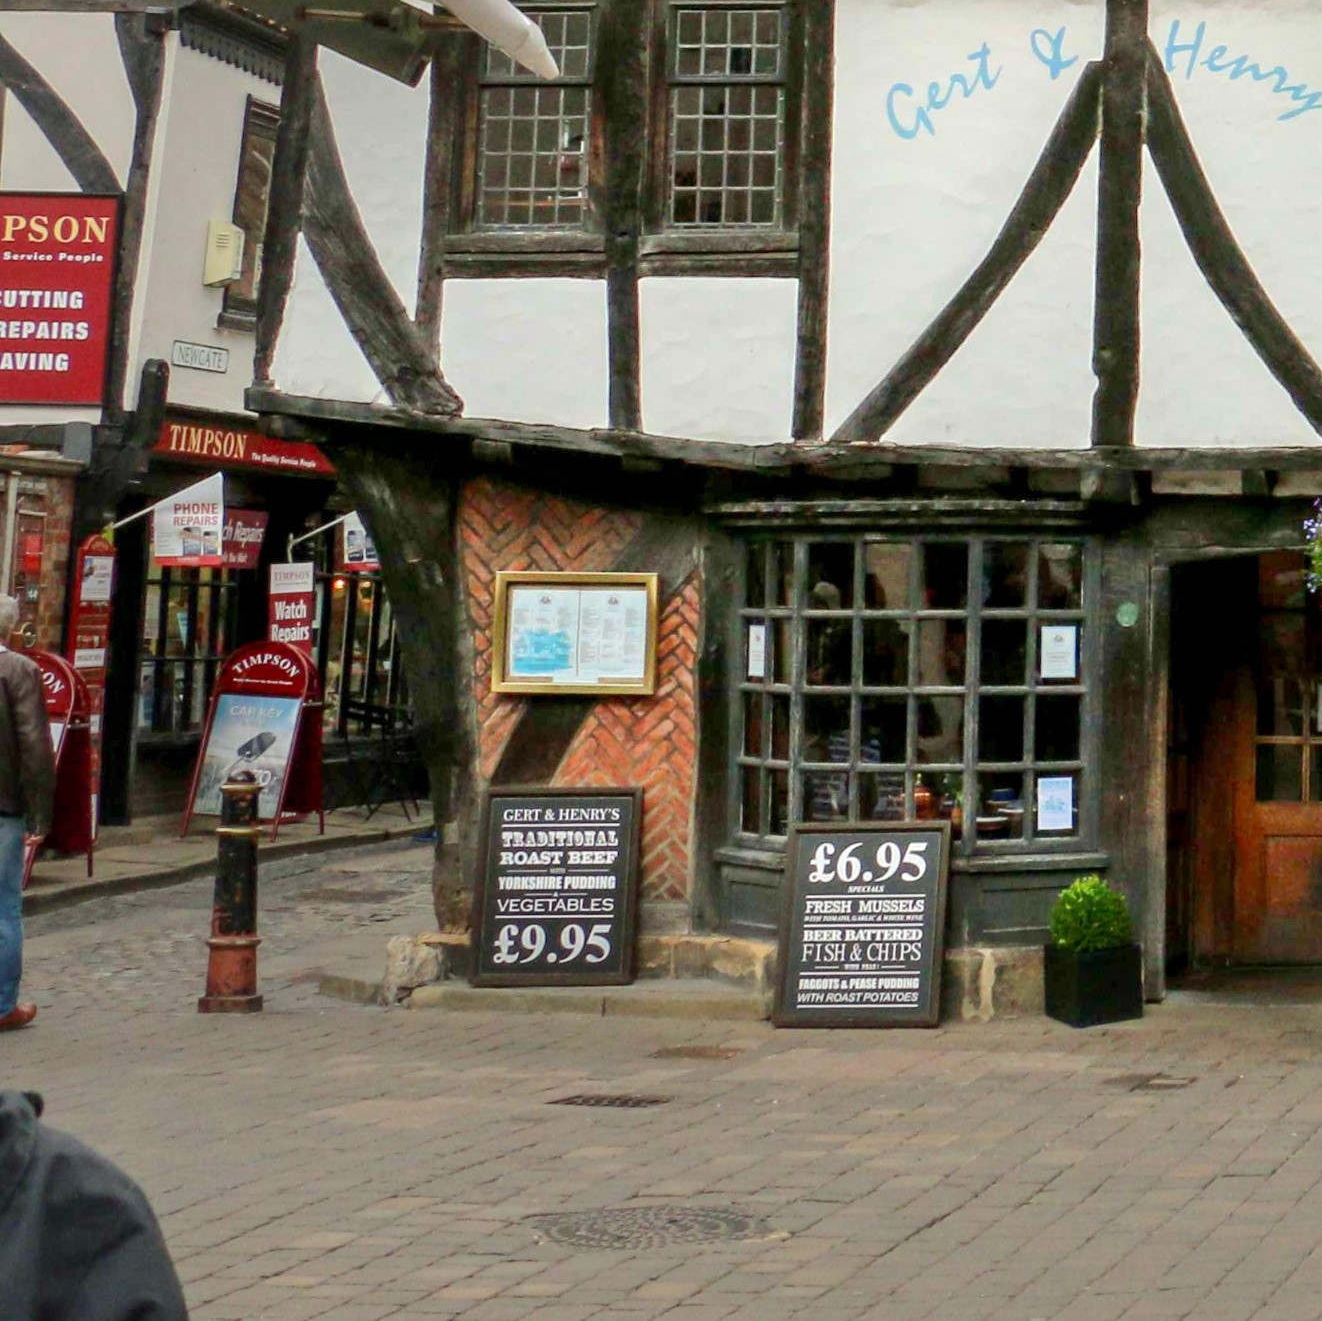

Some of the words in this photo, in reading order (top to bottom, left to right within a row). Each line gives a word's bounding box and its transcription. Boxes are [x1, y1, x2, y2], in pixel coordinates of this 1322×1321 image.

[885, 41, 1003, 141] Gert
[1030, 25, 1079, 79] &
[3, 251, 53, 262] Service
[58, 252, 104, 264] People
[0, 289, 84, 310] UTTING
[177, 344, 223, 370] NEWGATE
[169, 424, 248, 460] TIMPSON
[173, 503, 219, 515] PHONE
[173, 516, 218, 527] REPAIRS
[274, 599, 307, 620] Watch
[270, 621, 310, 643] Repairs
[232, 653, 300, 678] TIMPSON
[503, 808, 543, 822] GERT
[544, 808, 556, 821] &
[558, 808, 621, 821] HENRY'S
[501, 830, 619, 848] TRADITIONAL
[499, 851, 564, 866] ROAST
[566, 850, 619, 865] BEEF
[808, 842, 929, 883] £6.95
[498, 876, 563, 891] YORKSHIRE
[563, 876, 617, 890] PUDDING
[847, 885, 886, 894] SPECIALS
[496, 898, 615, 913] VEGETABLES
[804, 900, 853, 914] FRESH
[858, 899, 926, 913] MUSSELS
[802, 929, 843, 942] BEER
[844, 928, 924, 942] BATTERED
[492, 923, 613, 965] £9.95
[801, 943, 847, 963] FISH
[849, 942, 863, 962] &
[866, 942, 922, 961] CHIPS
[798, 978, 840, 990] FAGGOTS
[840, 979, 848, 989] &
[849, 978, 877, 989] PEASE
[878, 977, 920, 989] PUDDING
[797, 993, 825, 1003] WITH
[825, 992, 863, 1003] ROAST
[863, 991, 919, 1002] POTATOES
